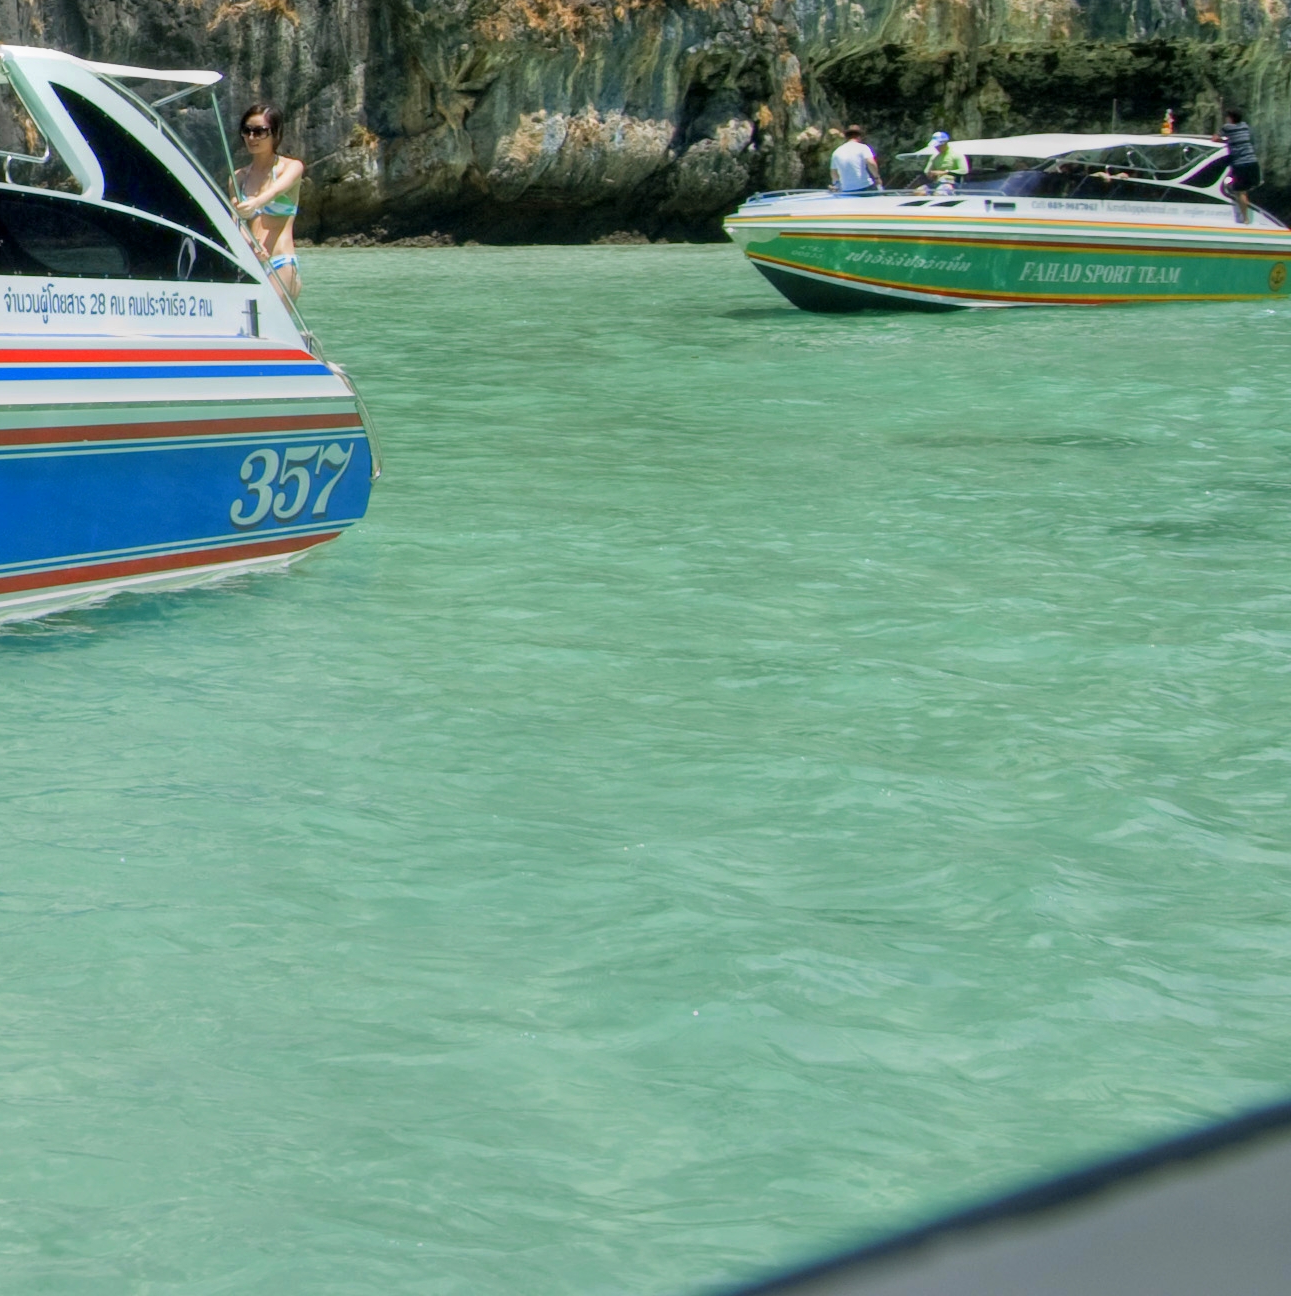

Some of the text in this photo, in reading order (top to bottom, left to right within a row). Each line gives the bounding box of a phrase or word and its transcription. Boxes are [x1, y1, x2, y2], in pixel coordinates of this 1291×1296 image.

[1019, 261, 1182, 284] FAHAD SPORT TEAM
[4, 283, 213, 324] จำนวนผู้โดยสาร 28 คน คนประจำเรือ 2 คน
[230, 441, 355, 529] 357
